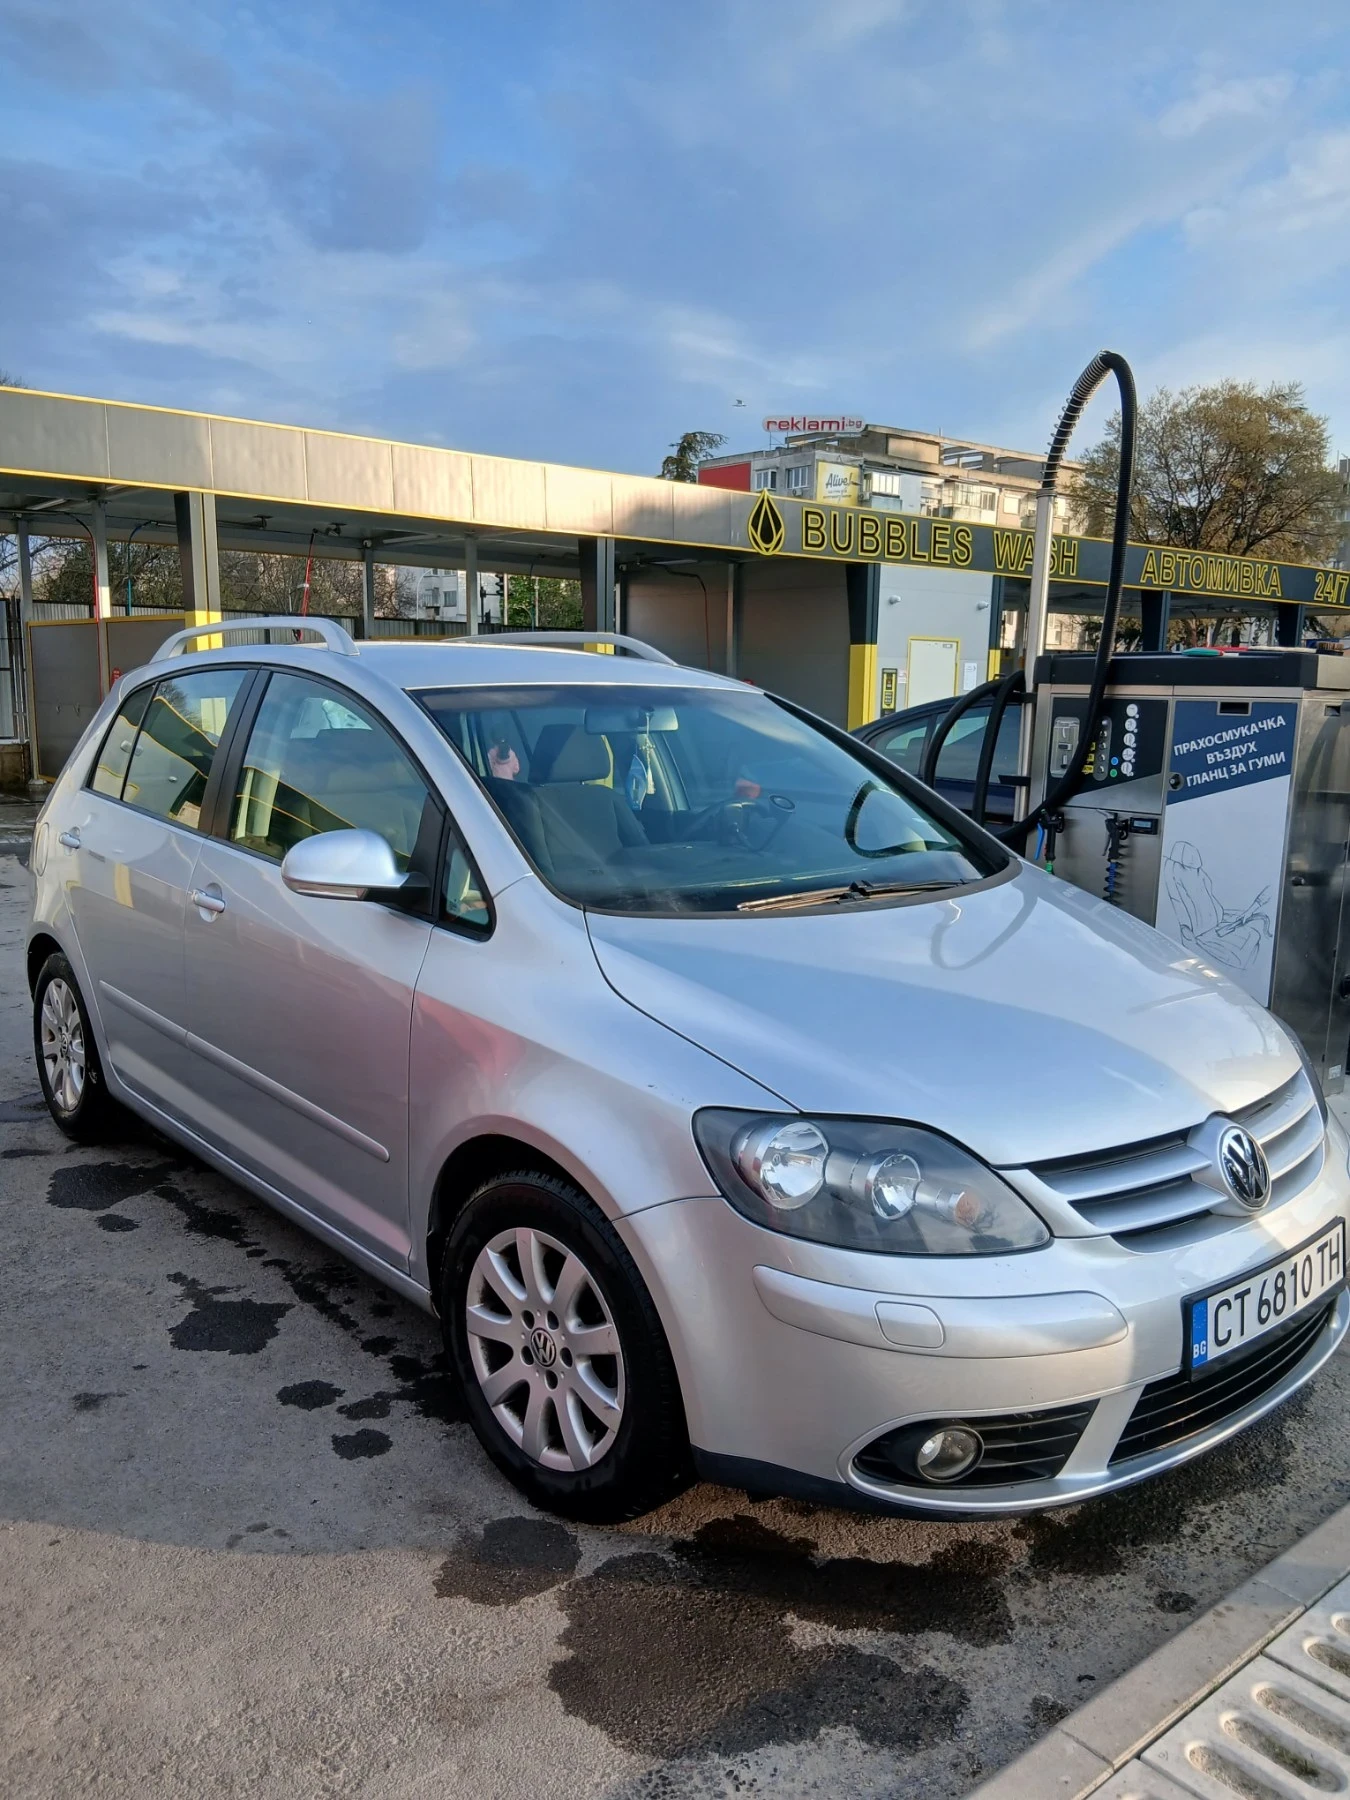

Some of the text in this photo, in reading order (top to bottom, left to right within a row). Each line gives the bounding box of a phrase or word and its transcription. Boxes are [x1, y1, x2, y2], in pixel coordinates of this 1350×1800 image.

[766, 416, 863, 431] reklami.bg
[802, 506, 973, 567] BUBBLES
[1140, 550, 1350, 604] АВТОМИВКА 24/7
[1173, 715, 1286, 756] ПРАХОСМУКАЧКА
[1206, 741, 1258, 764] ВЪЗДУХ
[1186, 751, 1286, 787] ГЛАНЦ ЗА ГУМИ
[1213, 1232, 1340, 1347] CT 6810 TH
[1192, 1340, 1207, 1358] BG
